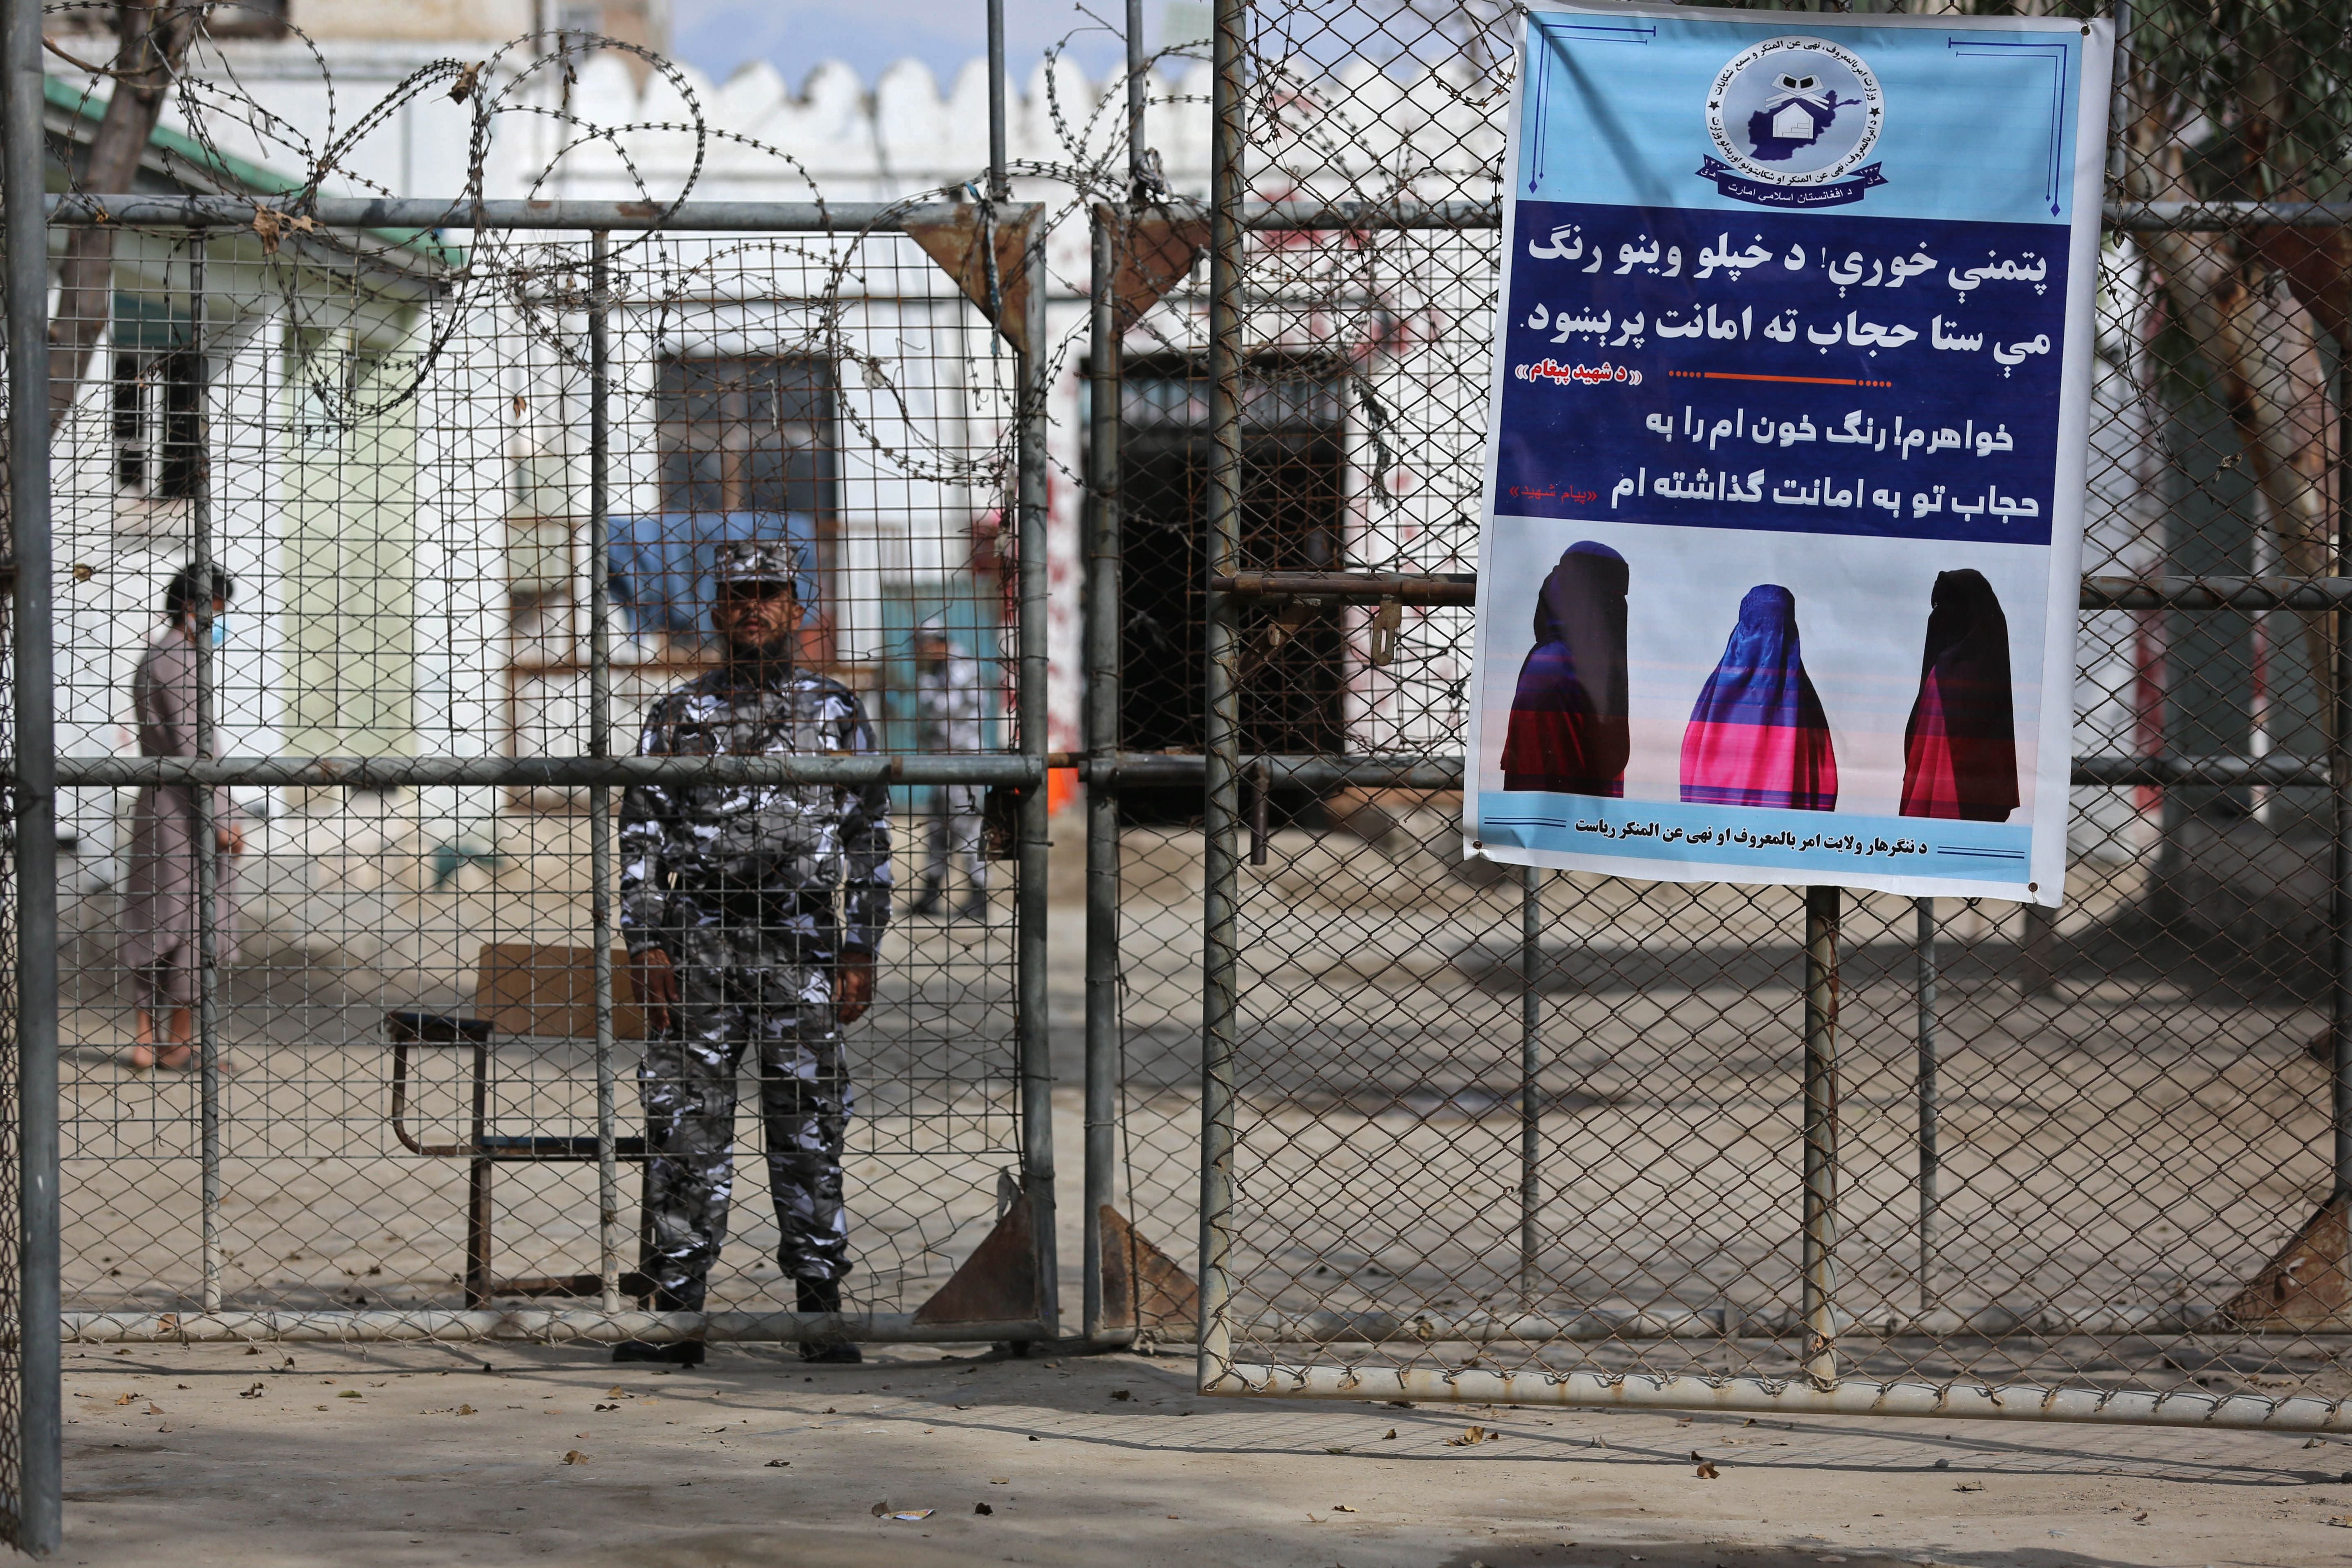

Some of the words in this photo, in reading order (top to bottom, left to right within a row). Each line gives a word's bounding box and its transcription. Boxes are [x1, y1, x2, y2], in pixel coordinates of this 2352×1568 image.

[1728, 184, 1756, 196] امارت
[1797, 188, 1843, 203] افغانستان
[1614, 234, 1682, 277] وینو
[1693, 232, 1773, 282] خپلو
[1784, 244, 1806, 271] د
[1655, 303, 1752, 341] امانت
[1764, 308, 1798, 343] ته
[1807, 310, 1919, 358] حجاب
[1932, 314, 1983, 351] ستا
[1993, 334, 2050, 378] مې
[1572, 362, 1613, 385] شهید
[1646, 411, 1673, 442] به
[1752, 414, 1816, 447] خون
[1611, 467, 1646, 510] ام
[1653, 468, 1765, 503] گذاشته
[1773, 477, 1864, 508] امانت
[1912, 484, 1946, 518] تو
[1872, 490, 1901, 518] به
[1951, 484, 2039, 524] حجاب
[1575, 819, 1616, 839] ریاست
[1662, 827, 1684, 842] عن
[1715, 827, 1731, 846] او
[1823, 835, 1863, 855] ولایت
[1918, 842, 1928, 855] د
